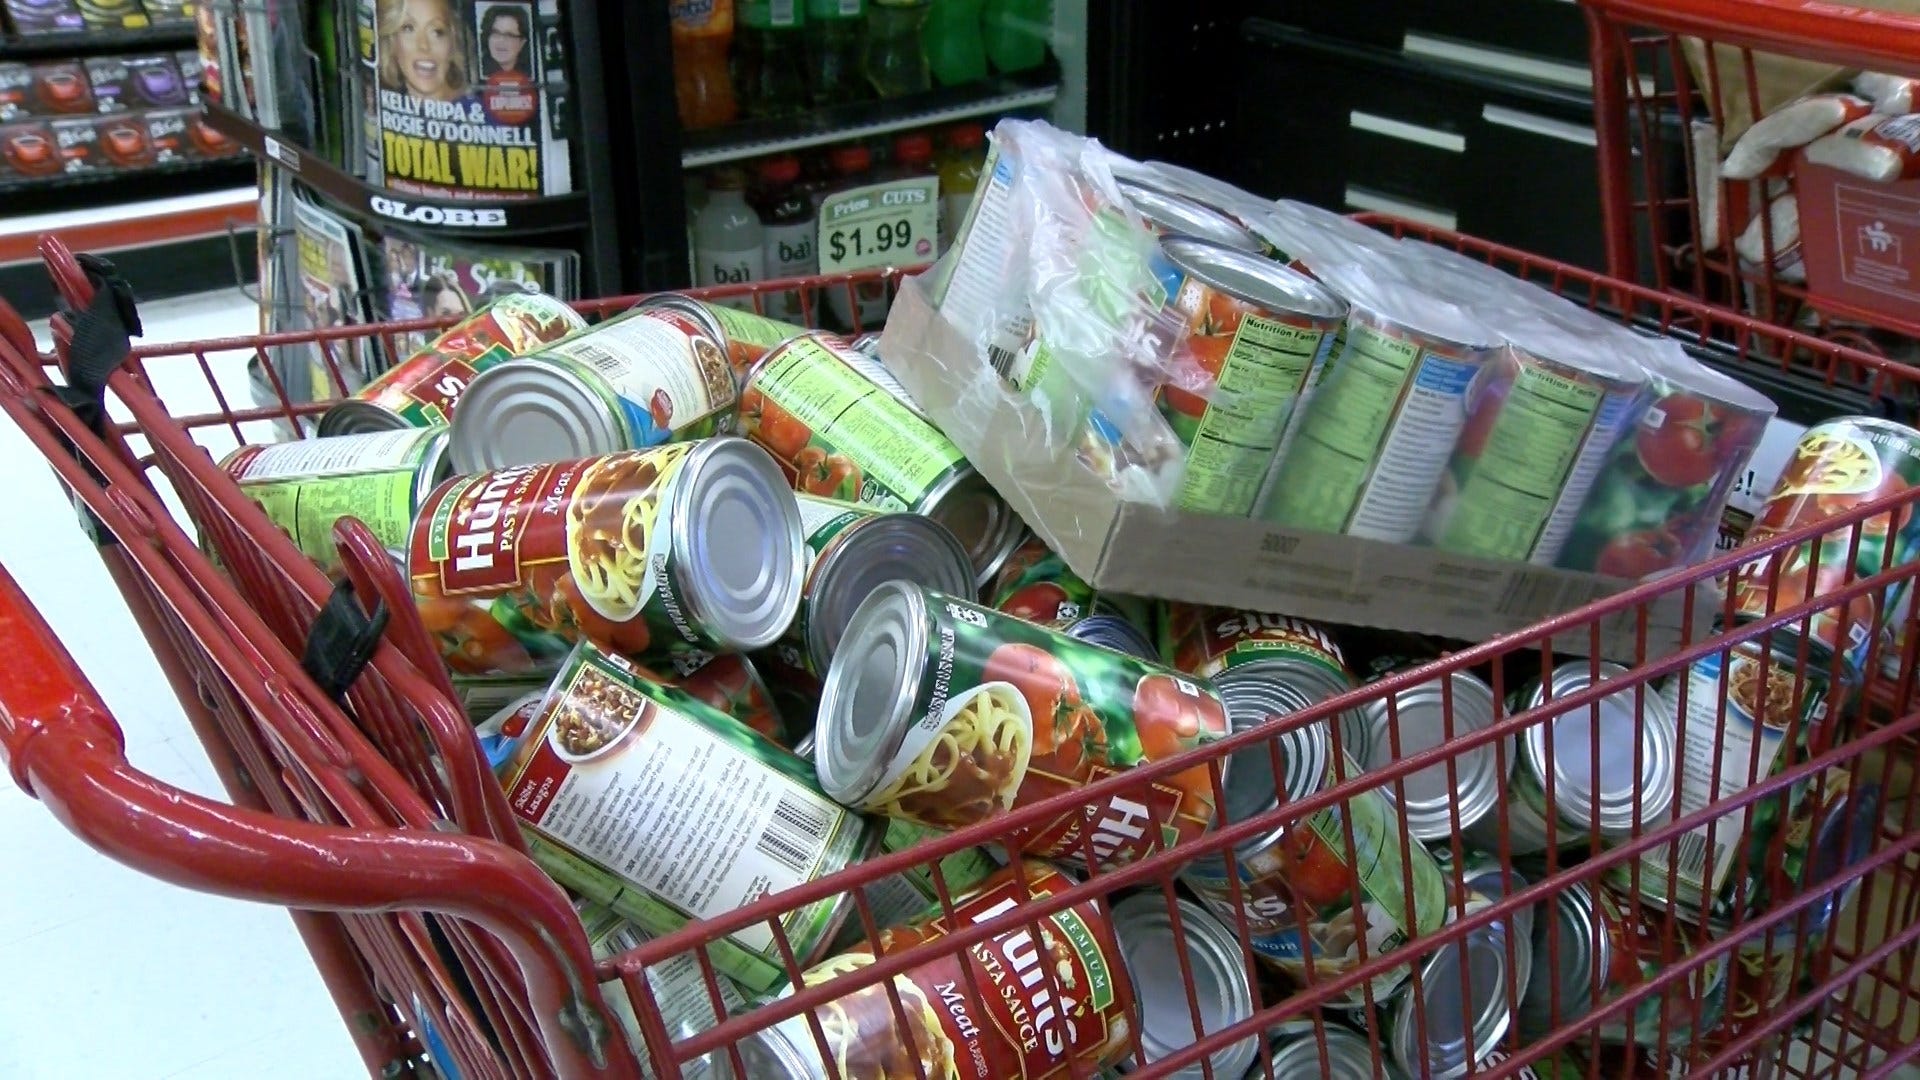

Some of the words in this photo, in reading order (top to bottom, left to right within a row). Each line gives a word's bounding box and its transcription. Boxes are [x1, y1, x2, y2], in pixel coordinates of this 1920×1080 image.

[381, 89, 422, 117] KELLY
[425, 99, 467, 121] RIPA
[468, 102, 485, 124] &
[382, 110, 426, 137] ROSIE
[427, 121, 537, 147] O'DONNELL
[383, 131, 456, 184] TOTAL
[457, 145, 538, 190] WAR!
[371, 195, 507, 226] GLOBE
[882, 188, 926, 205] CUTS
[779, 235, 811, 262] bai
[829, 219, 912, 264] $1.99
[470, 261, 541, 295] Stle
[713, 263, 751, 284] bai
[1246, 318, 1292, 338] Nutrition
[500, 497, 523, 551] PASTA
[1059, 912, 1105, 990] REMIUM
[934, 980, 980, 1038] Meat
[970, 941, 1006, 986] ASTA
[1000, 984, 1040, 1054] SAUCE
